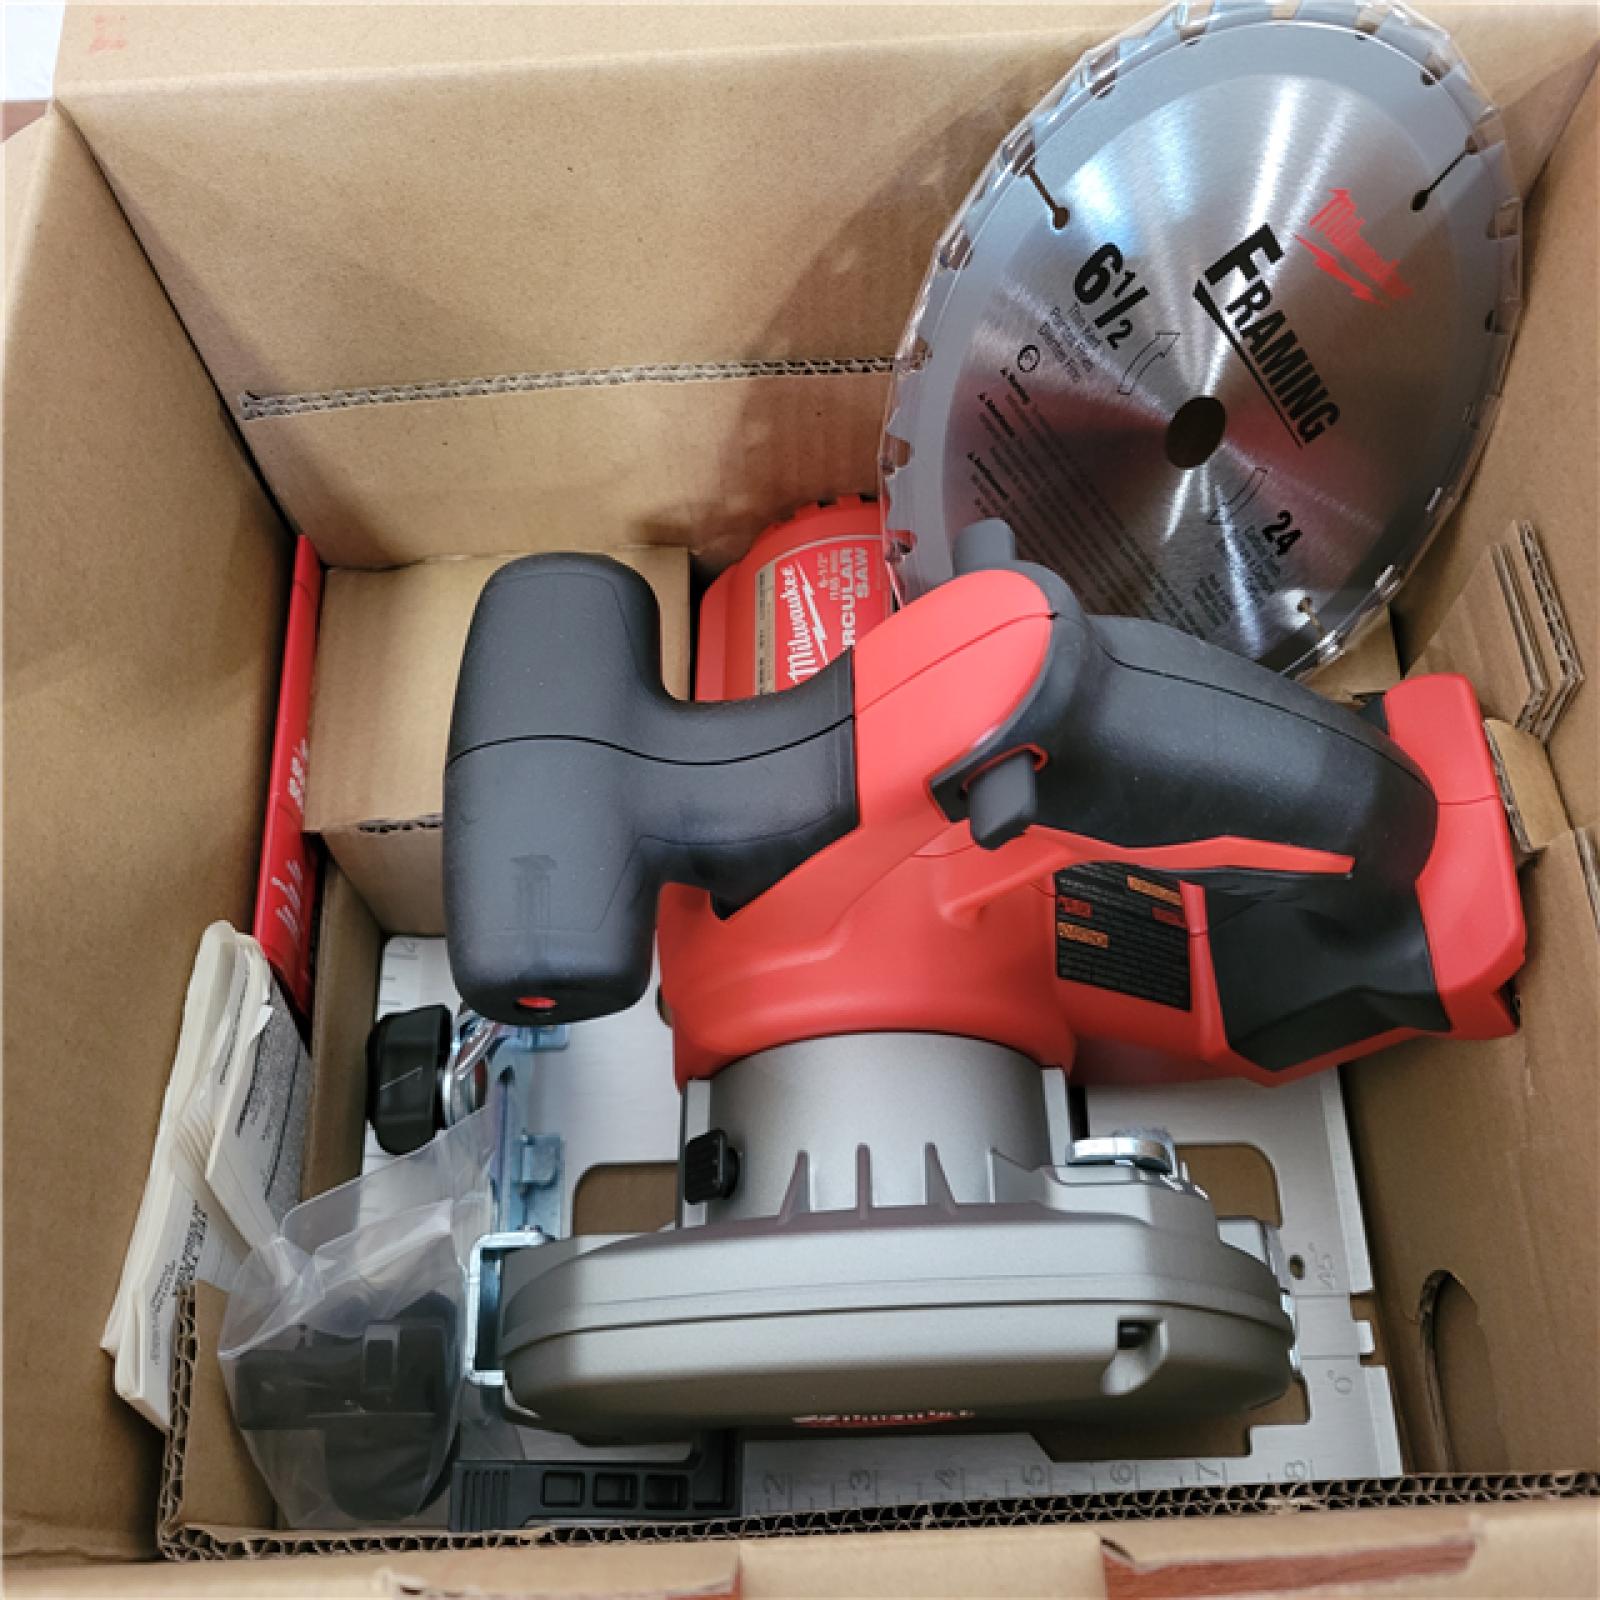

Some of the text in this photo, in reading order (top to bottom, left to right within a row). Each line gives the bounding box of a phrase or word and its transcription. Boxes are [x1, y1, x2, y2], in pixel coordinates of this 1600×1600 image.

[1262, 509, 1303, 555] 24
[854, 547, 870, 599] SAW
[780, 561, 822, 684] Milwaukee
[763, 1472, 785, 1496] 2
[850, 1469, 871, 1491] 3
[1022, 1464, 1045, 1486] 5
[1195, 1461, 1220, 1481] 7
[1285, 1459, 1307, 1480] 8
